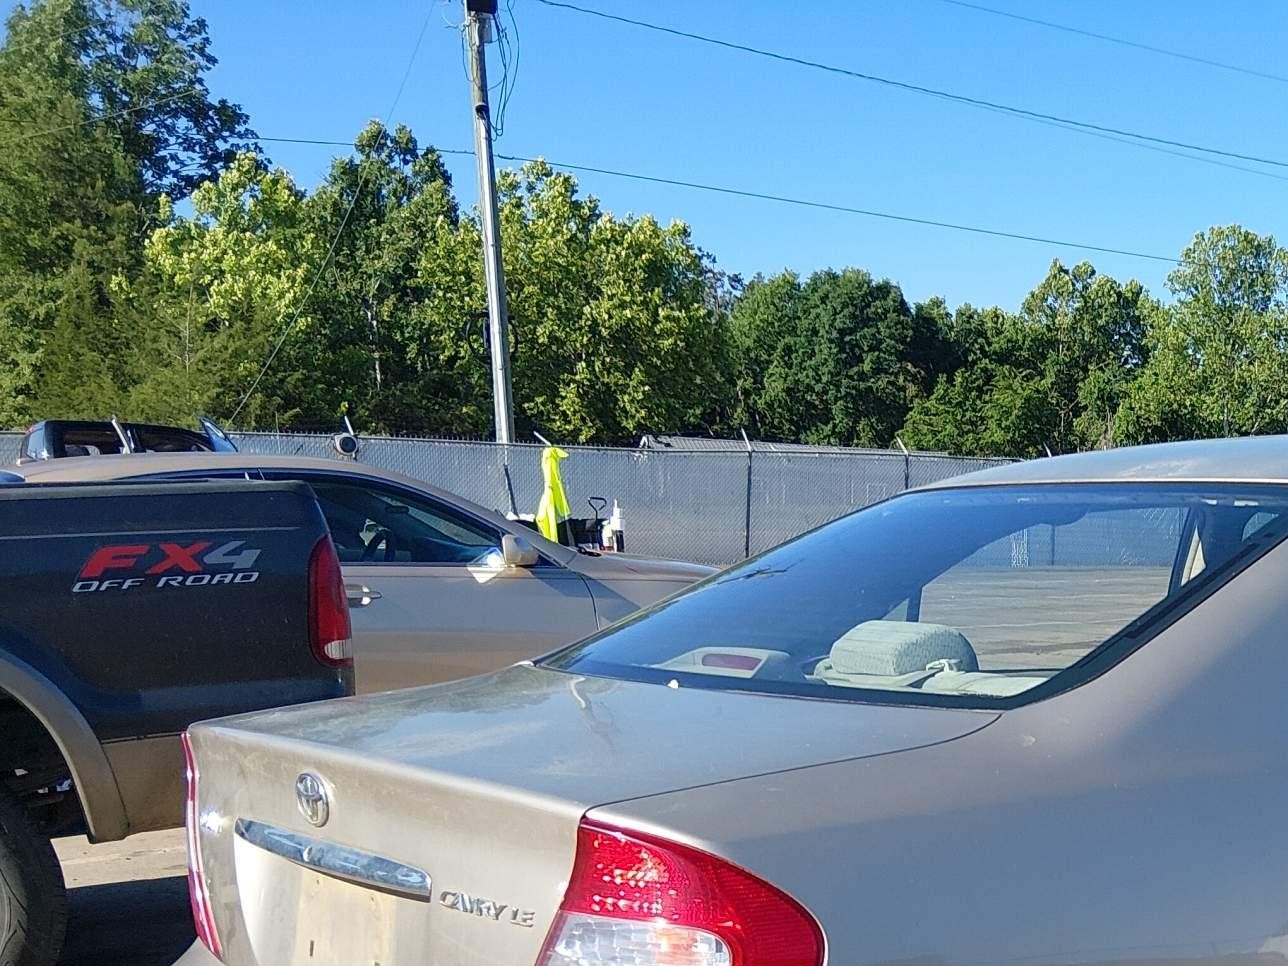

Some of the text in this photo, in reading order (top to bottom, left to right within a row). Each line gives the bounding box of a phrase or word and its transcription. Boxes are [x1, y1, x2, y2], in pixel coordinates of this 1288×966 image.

[79, 540, 262, 579] FX4
[72, 571, 259, 593] OFF ROAD
[439, 890, 536, 928] CAMRY LE
